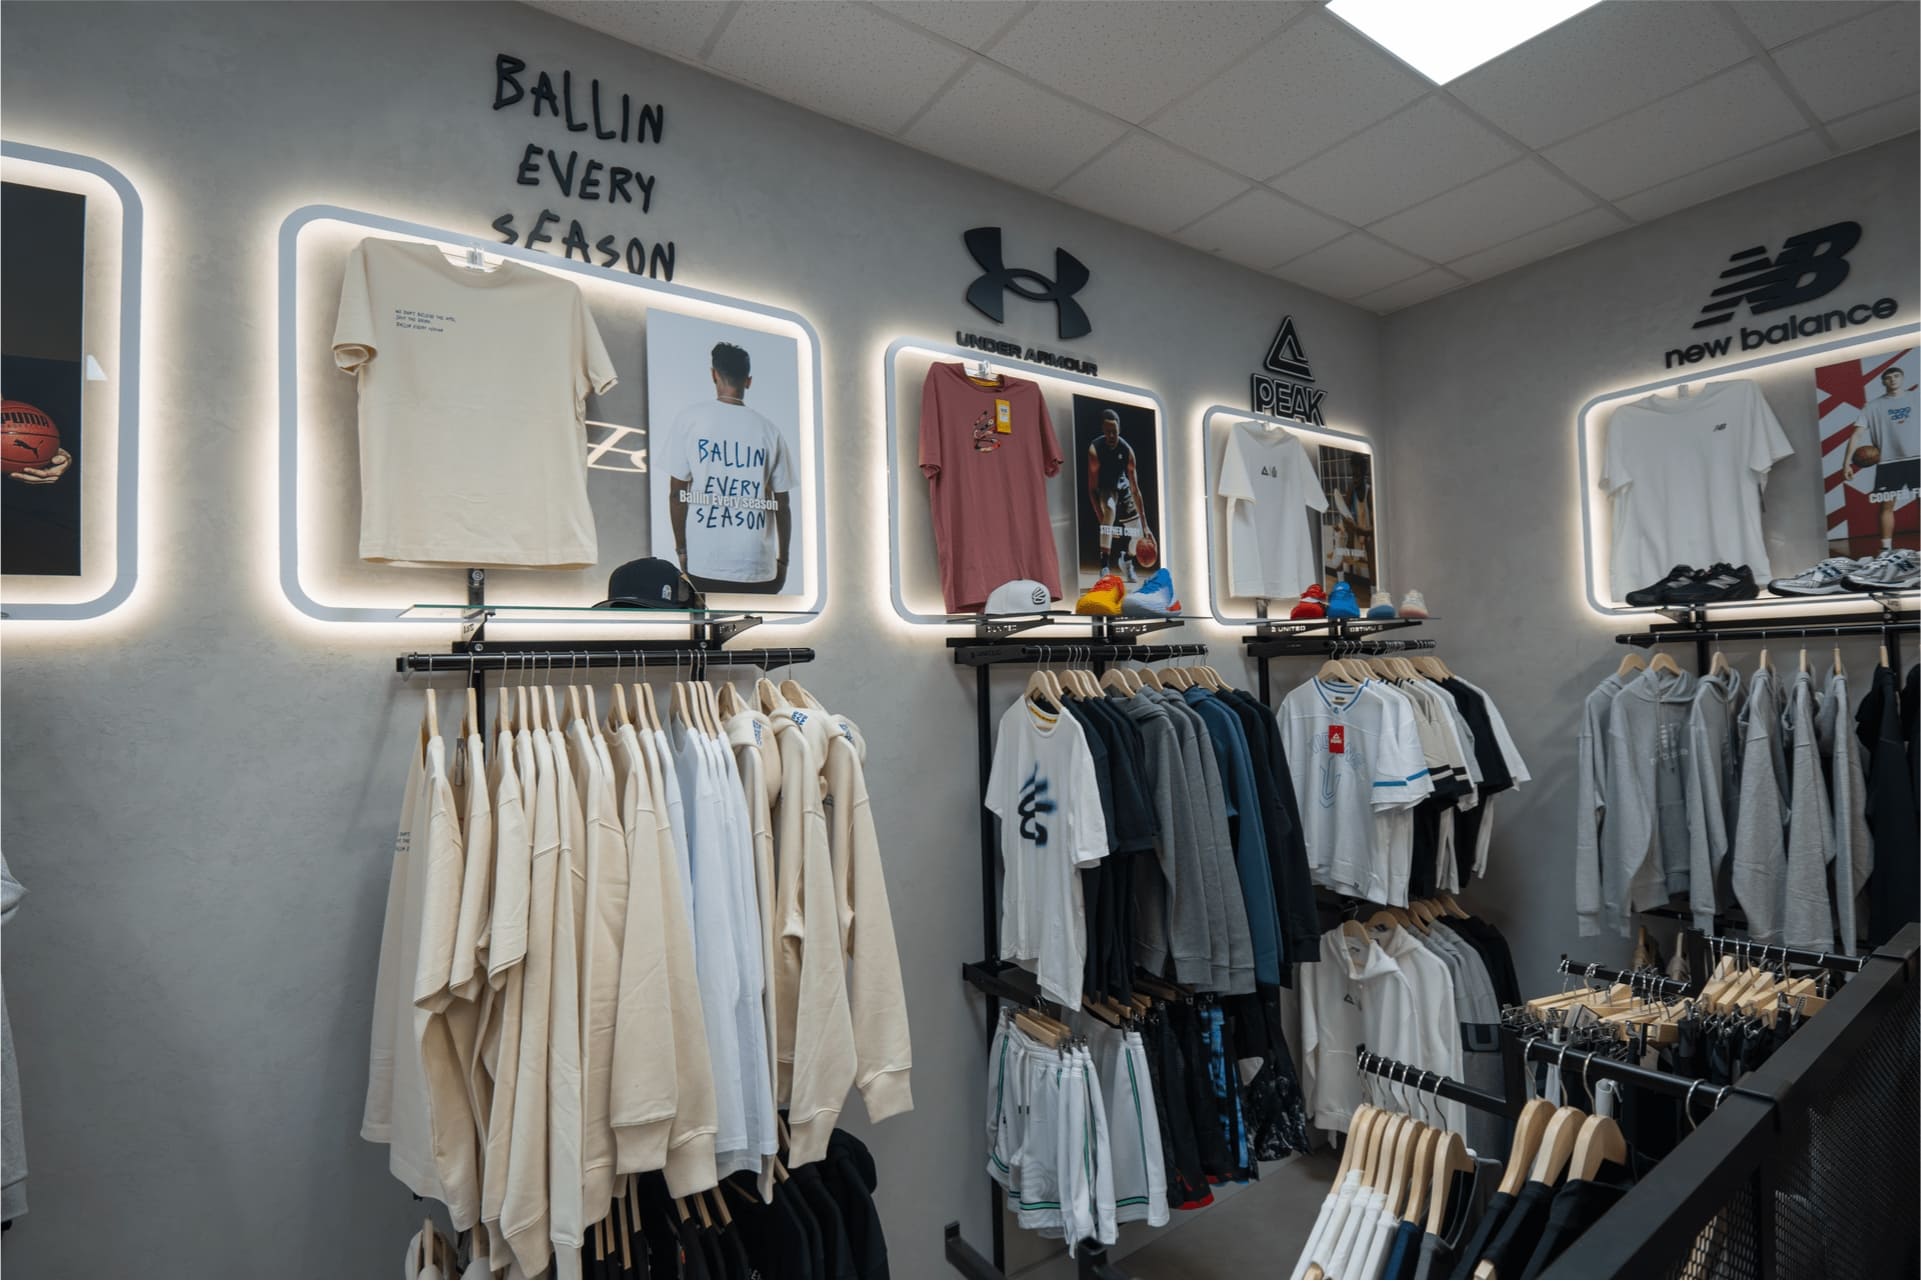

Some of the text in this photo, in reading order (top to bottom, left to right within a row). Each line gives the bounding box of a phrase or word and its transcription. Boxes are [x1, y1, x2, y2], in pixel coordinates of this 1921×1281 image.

[493, 53, 664, 144] BALLIN
[517, 143, 656, 214] EVERY
[492, 209, 676, 281] SEASON
[956, 331, 1098, 377] UNDER ARMOUR
[1665, 298, 1898, 368] new balance
[1, 411, 50, 428] PUMA
[1251, 373, 1327, 428] PEAK
[698, 438, 765, 468] BALLIN
[679, 489, 779, 511] Ballin Every season
[705, 475, 761, 499] EVERY
[696, 505, 766, 530] SEASON
